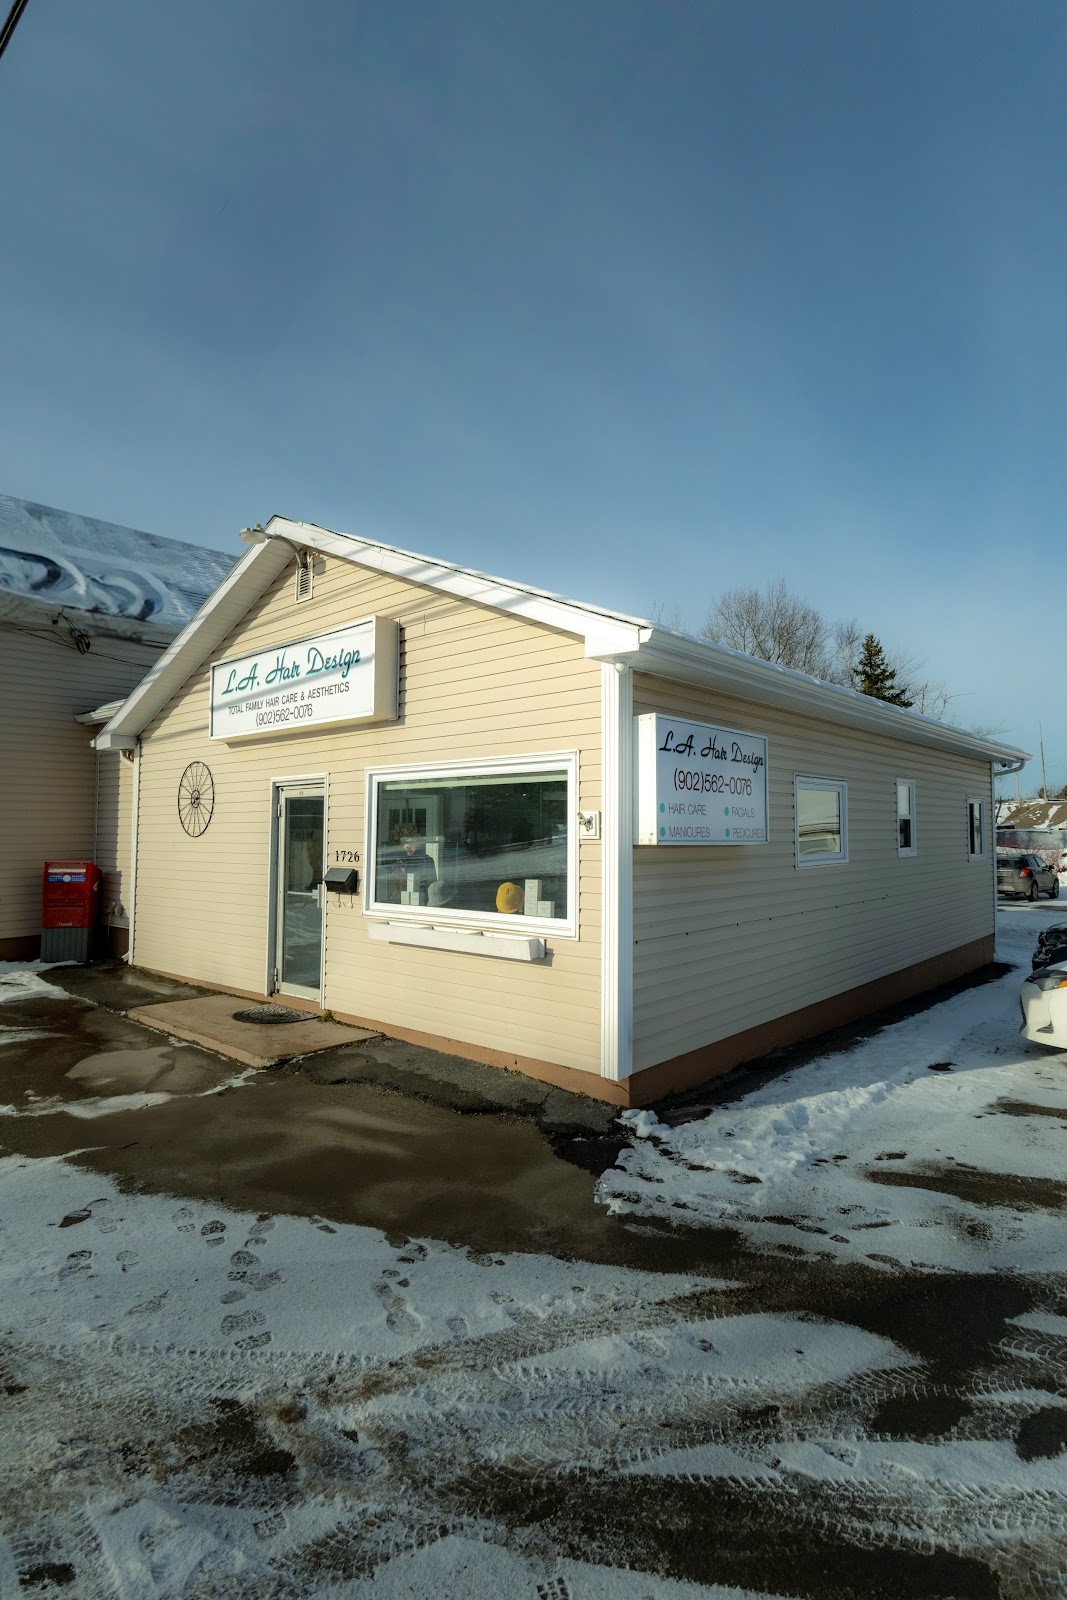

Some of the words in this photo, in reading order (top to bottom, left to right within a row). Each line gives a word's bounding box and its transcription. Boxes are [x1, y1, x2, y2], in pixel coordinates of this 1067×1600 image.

[221, 662, 260, 695] L.A.
[265, 649, 300, 684] Hair
[305, 647, 361, 678] Design
[228, 704, 244, 715] TOTAL
[245, 699, 264, 711] FAMILY
[265, 695, 280, 707] HAIR
[281, 693, 298, 705] CARE
[300, 691, 305, 701] &
[307, 681, 350, 700] AESTHETICS
[255, 704, 313, 727] (902)562-0076
[658, 730, 696, 757] L.A.
[700, 733, 728, 760] Hair
[730, 742, 764, 773] Design
[673, 768, 752, 796] (902)562-0076
[668, 803, 686, 815] HAIR
[687, 803, 707, 816] CARE
[731, 806, 755, 818] FACIALS
[668, 826, 711, 838] MANICURES
[732, 828, 765, 839] PEDICURES
[335, 850, 360, 862] 1726
